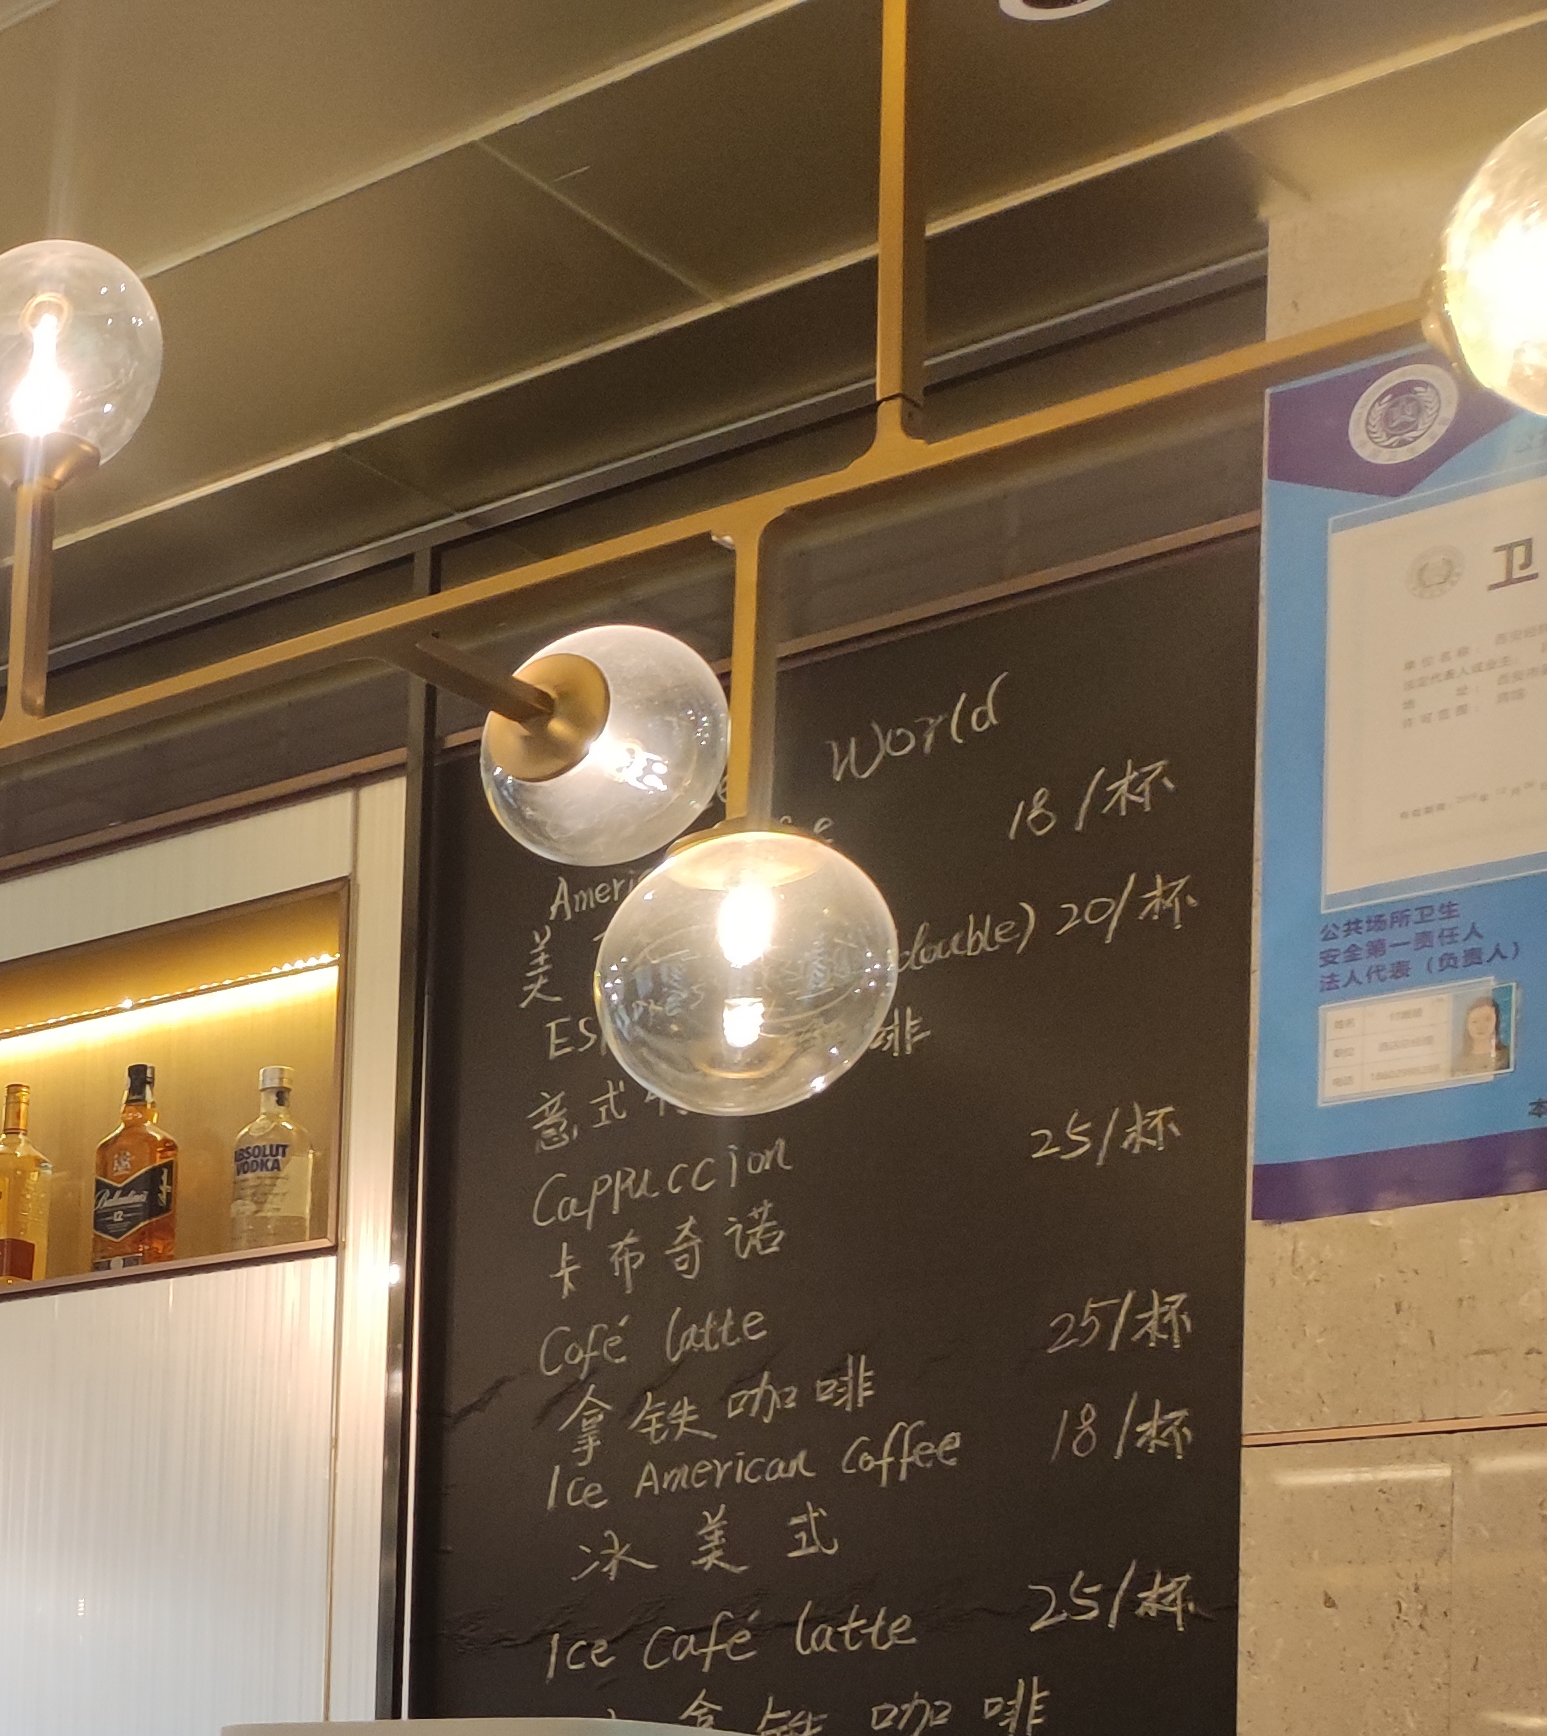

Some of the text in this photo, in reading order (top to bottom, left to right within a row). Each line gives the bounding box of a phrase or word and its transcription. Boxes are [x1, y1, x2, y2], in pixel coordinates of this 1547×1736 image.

[1486, 537, 1539, 591] 卫
[1318, 921, 1484, 968] 安全第一责任人
[1319, 901, 1460, 942] 公共场所卫生
[235, 1158, 282, 1177] VODKA
[549, 1200, 790, 1300] 卡布奇诺
[569, 1500, 841, 1584] 冰美式
